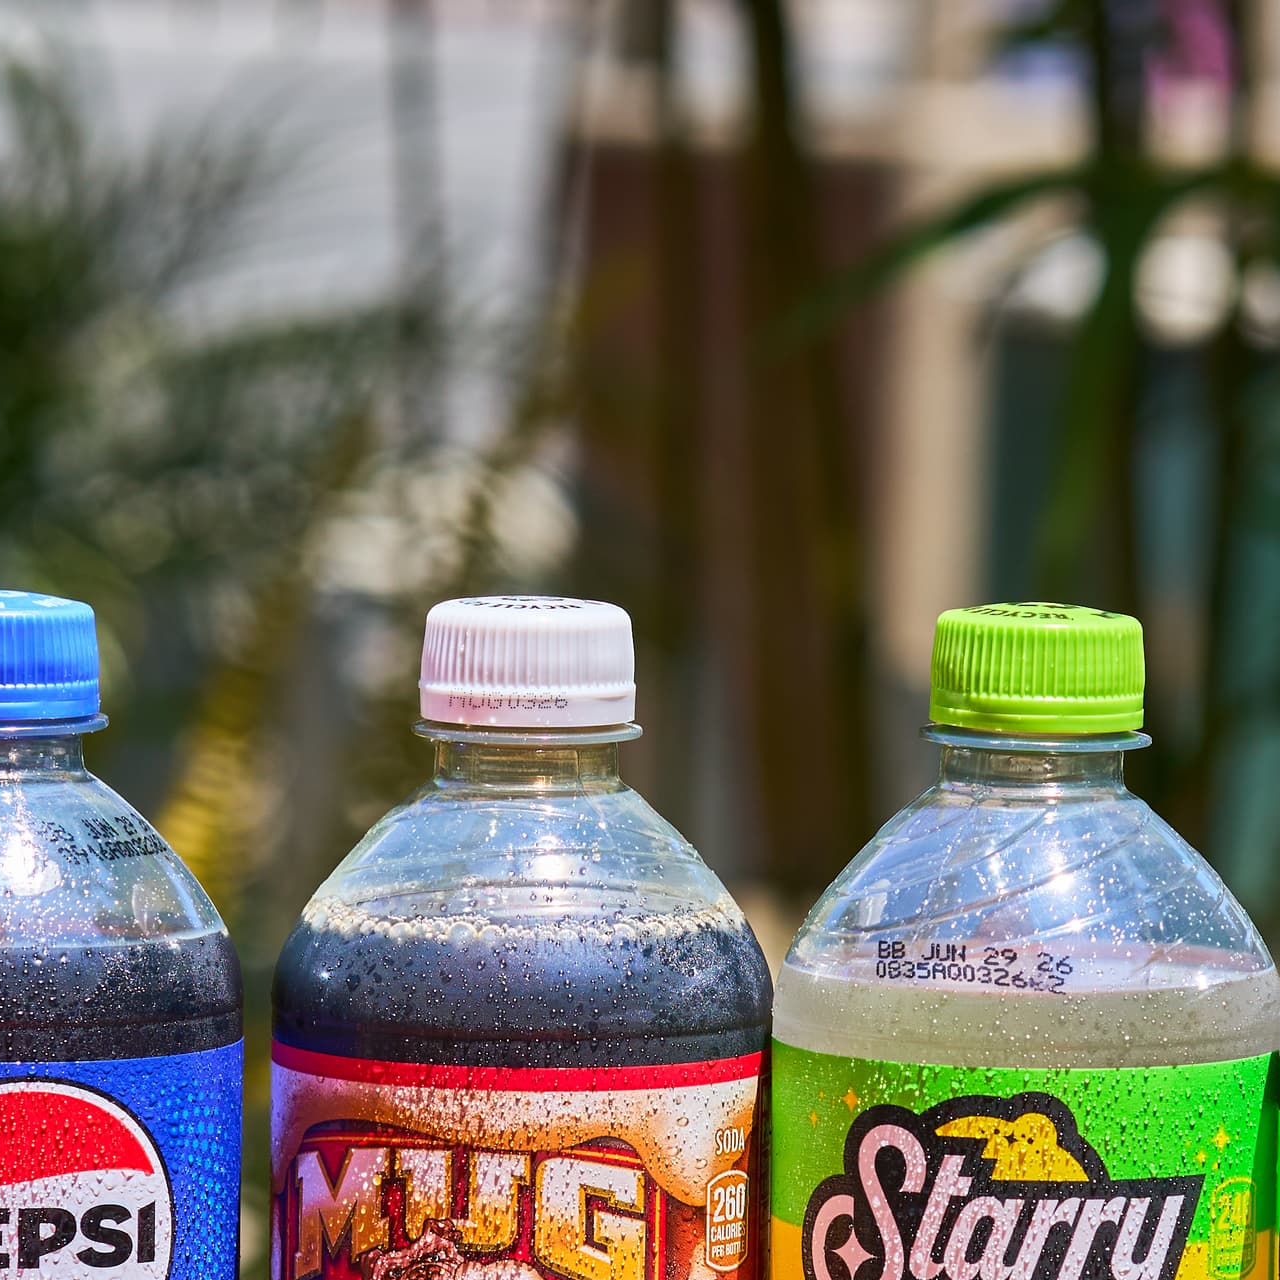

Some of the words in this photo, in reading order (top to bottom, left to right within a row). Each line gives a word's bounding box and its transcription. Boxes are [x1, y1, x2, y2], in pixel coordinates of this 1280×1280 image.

[876, 939, 907, 960] BB
[920, 941, 968, 963] JUN
[982, 945, 1019, 968] 29
[1036, 950, 1075, 976] 26
[714, 1127, 746, 1155] SODA
[712, 1182, 746, 1223] 260
[710, 1221, 746, 1243] CALORIES
